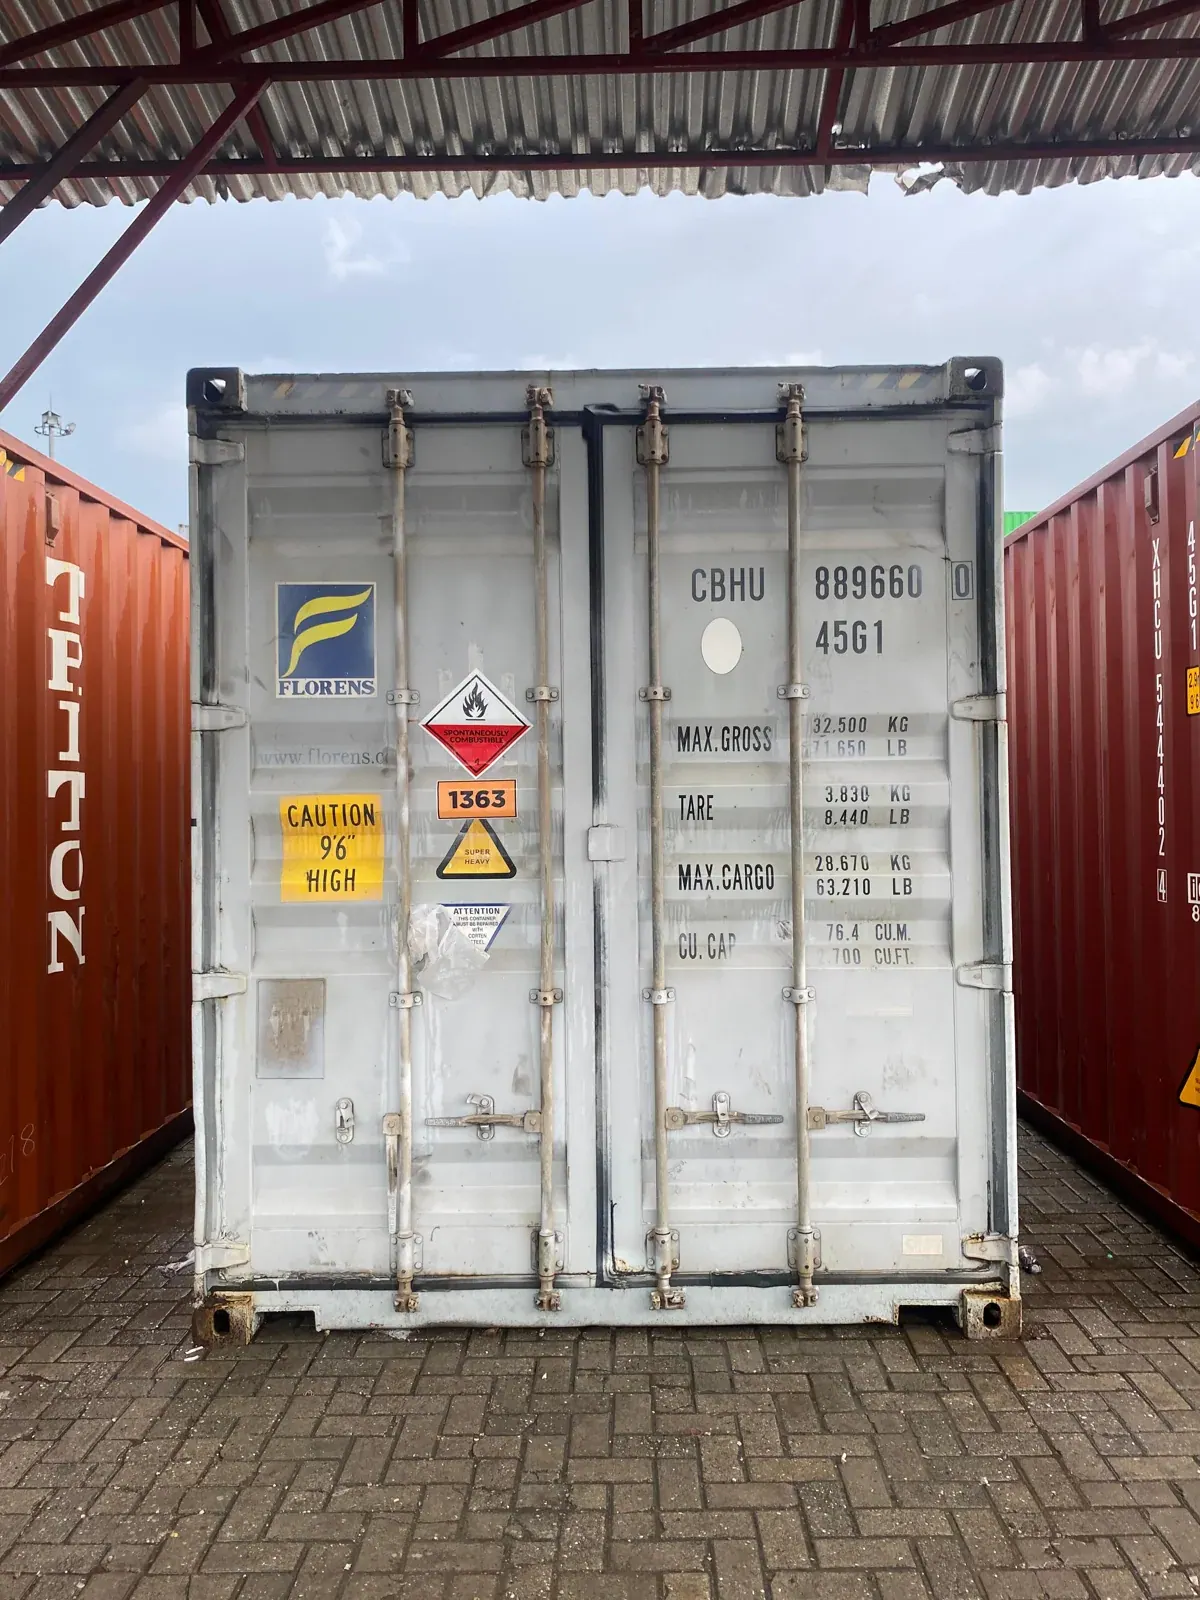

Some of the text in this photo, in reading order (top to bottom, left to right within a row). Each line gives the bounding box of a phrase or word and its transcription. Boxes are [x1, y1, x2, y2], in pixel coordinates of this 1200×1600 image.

[691, 563, 969, 602] CBHU 889660 0
[1188, 520, 1197, 650] 45G1
[1152, 537, 1162, 660] XHCU
[815, 620, 883, 654] 45G1
[278, 680, 375, 695] FLORENS
[888, 716, 909, 732] KG
[813, 739, 907, 757] 71650 LB
[45, 556, 86, 974] TRITON
[1156, 673, 1165, 856] 544402
[448, 790, 506, 809] 1363
[891, 785, 911, 802] KG
[288, 803, 376, 827] CAUTION
[678, 794, 714, 821] TARE
[889, 809, 910, 825] LB
[891, 855, 911, 871] KG
[307, 869, 356, 892] HIGH
[892, 878, 912, 896] LB
[827, 924, 911, 941] 76.4 CU.M.
[678, 932, 737, 960] CU. CAP
[875, 948, 914, 965] CU.FT.
